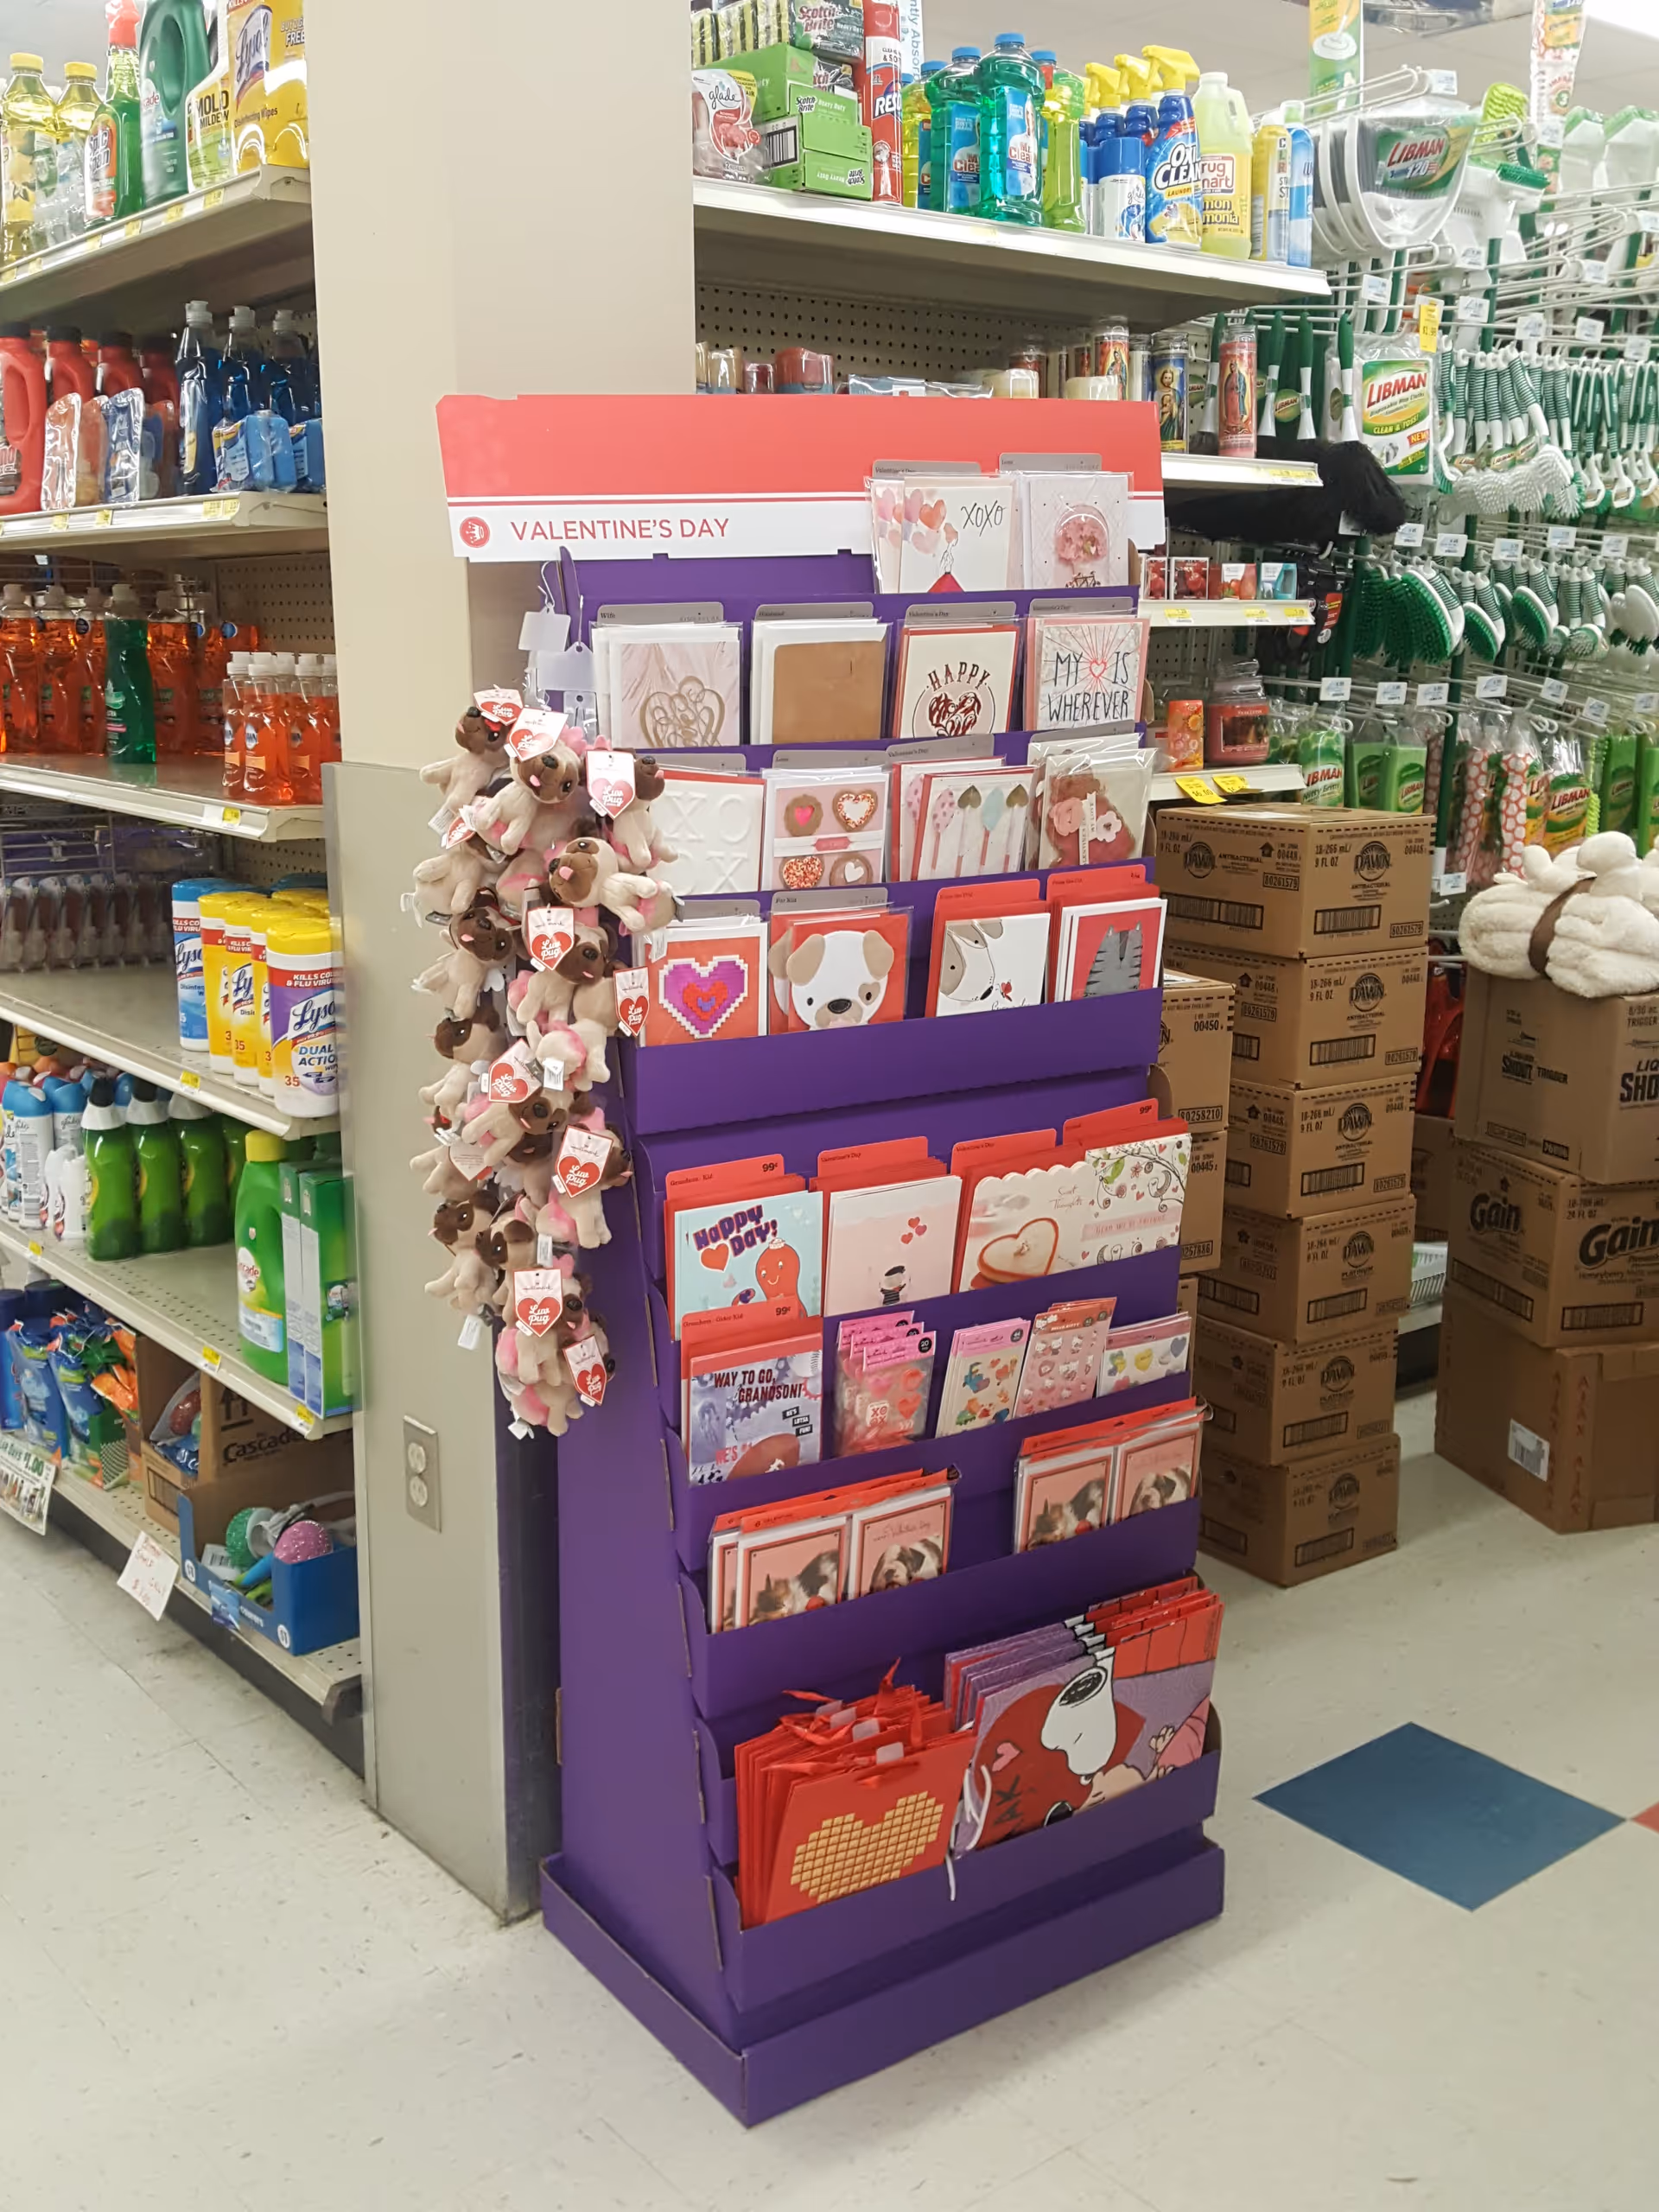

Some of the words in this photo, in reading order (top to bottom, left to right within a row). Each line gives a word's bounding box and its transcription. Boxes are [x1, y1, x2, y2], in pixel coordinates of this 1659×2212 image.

[798, 6, 837, 20] Scotch
[804, 17, 835, 32] Brite
[709, 84, 741, 109] glade
[796, 96, 816, 105] Scotch
[195, 90, 229, 118] MOLD
[798, 103, 815, 112] Brite
[1387, 137, 1446, 168] LIBMAN
[1367, 373, 1427, 409] LIBMAN
[1373, 424, 1393, 435] CLEAN
[960, 499, 1007, 537] XOXO
[511, 518, 672, 542] VALENTINE'S
[680, 518, 729, 538] DAY
[927, 661, 992, 692] HAPPY
[1053, 652, 1083, 688] MY
[1111, 652, 1130, 685] IS
[1047, 691, 1129, 723] WHEREVER
[1306, 768, 1343, 787] IBMAN
[602, 795, 624, 807] Pug
[1551, 787, 1591, 810] LIBMAN
[1321, 857, 1328, 868] FL
[1331, 856, 1338, 867] OZ
[1353, 852, 1392, 874] DAWN
[541, 939, 562, 951] Luv
[541, 947, 561, 960] Pug
[294, 979, 312, 988] FLU
[1316, 991, 1323, 1001] FL
[1325, 989, 1333, 1000] OZ
[1349, 983, 1386, 1005] DAWN
[627, 1003, 643, 1015] Luv
[627, 1013, 643, 1025] Pug
[299, 1043, 334, 1056] DUAL
[284, 1075, 301, 1087] 35
[494, 1080, 512, 1098] Pug
[1180, 1109, 1221, 1122] 80258210
[1338, 1112, 1374, 1135] DAWN
[569, 1164, 590, 1178] Luv
[566, 1173, 588, 1187] Pug
[1471, 1192, 1522, 1234] Gain
[529, 1304, 550, 1315] Luv
[528, 1313, 550, 1325] Pug
[920, 1339, 931, 1349] 20
[715, 1371, 737, 1389] WAY
[742, 1370, 755, 1386] TO
[758, 1368, 776, 1385] GO,
[588, 1382, 602, 1395] Pug
[738, 1382, 804, 1403] GRANDSON!
